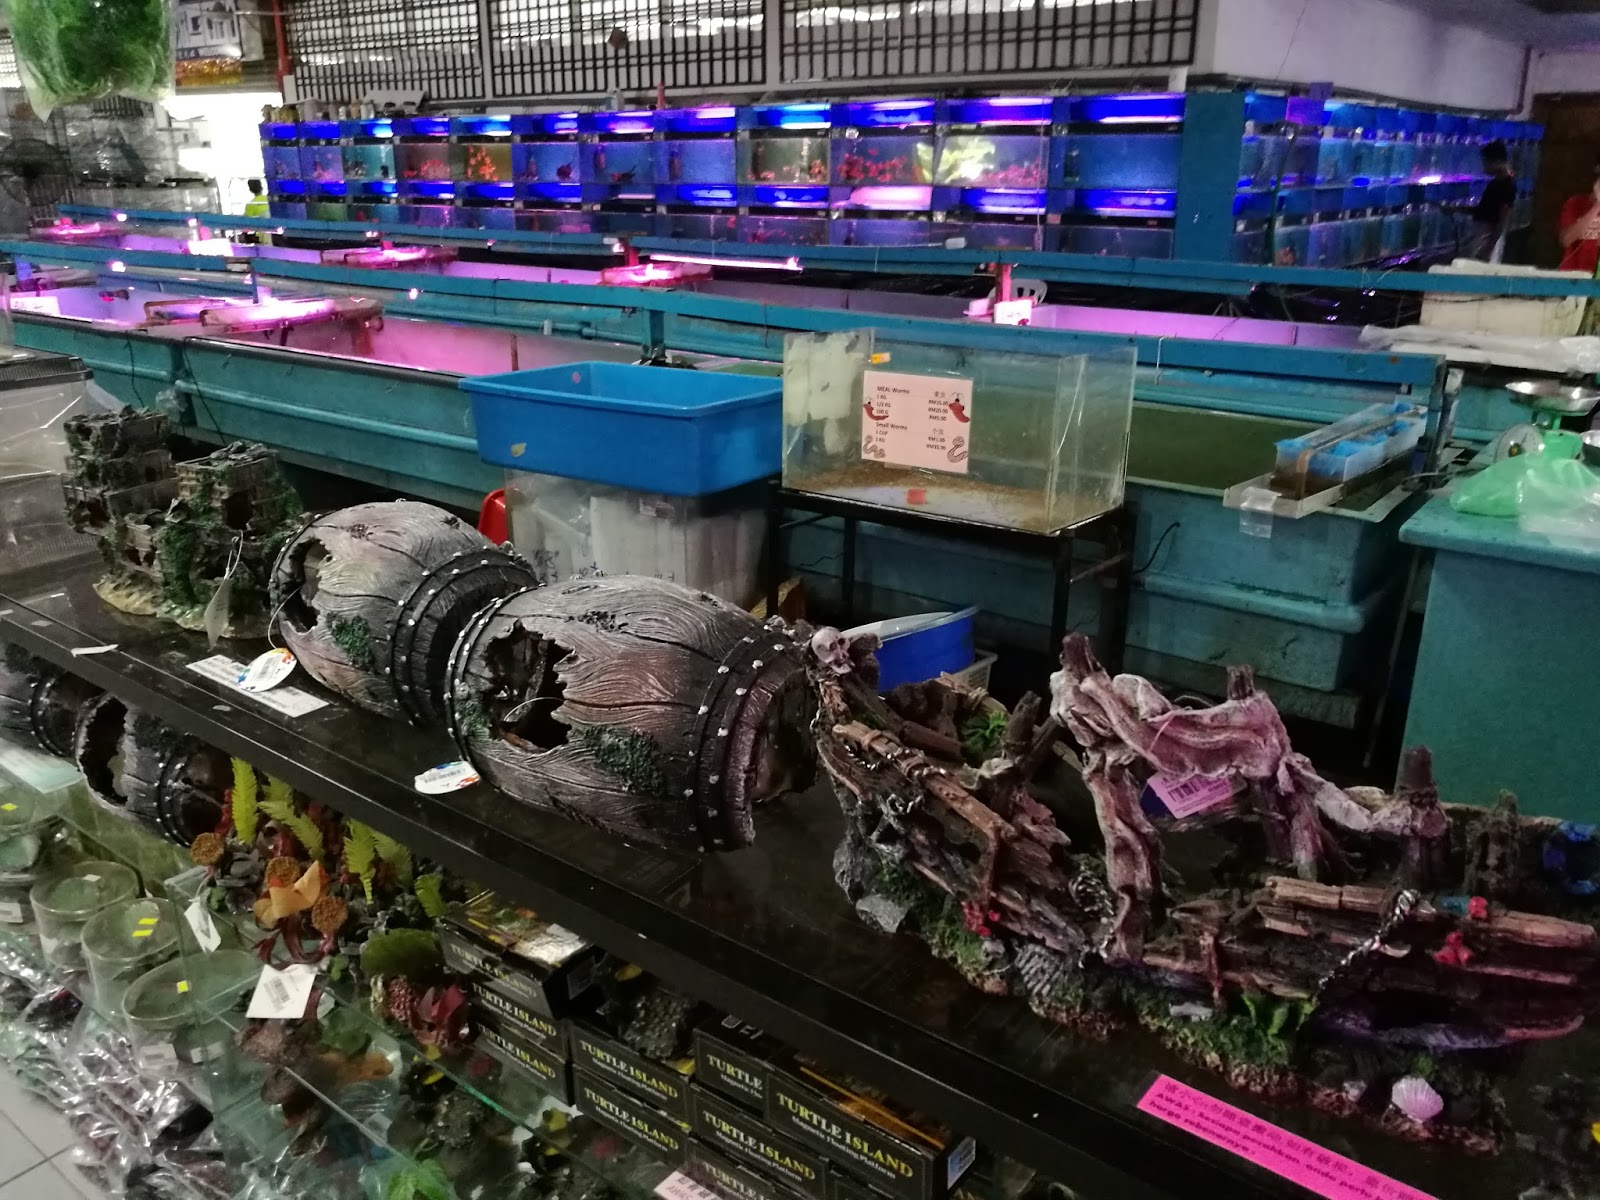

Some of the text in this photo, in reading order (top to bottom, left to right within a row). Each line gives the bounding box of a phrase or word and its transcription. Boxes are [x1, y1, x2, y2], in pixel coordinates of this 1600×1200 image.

[472, 982, 512, 1013] TURTLE
[514, 1003, 556, 1036] ISLAND
[515, 1048, 556, 1078] ISLAND
[580, 1040, 678, 1098] TURTLE ISLAND
[707, 1054, 762, 1090] TURTLE
[584, 1088, 679, 1149] TURTLE ISLAND
[703, 1110, 816, 1180] TURTLE ISLAND
[776, 1092, 842, 1139] TURTLE
[845, 1131, 913, 1178] ISLAND
[703, 1161, 757, 1198] TURTLE
